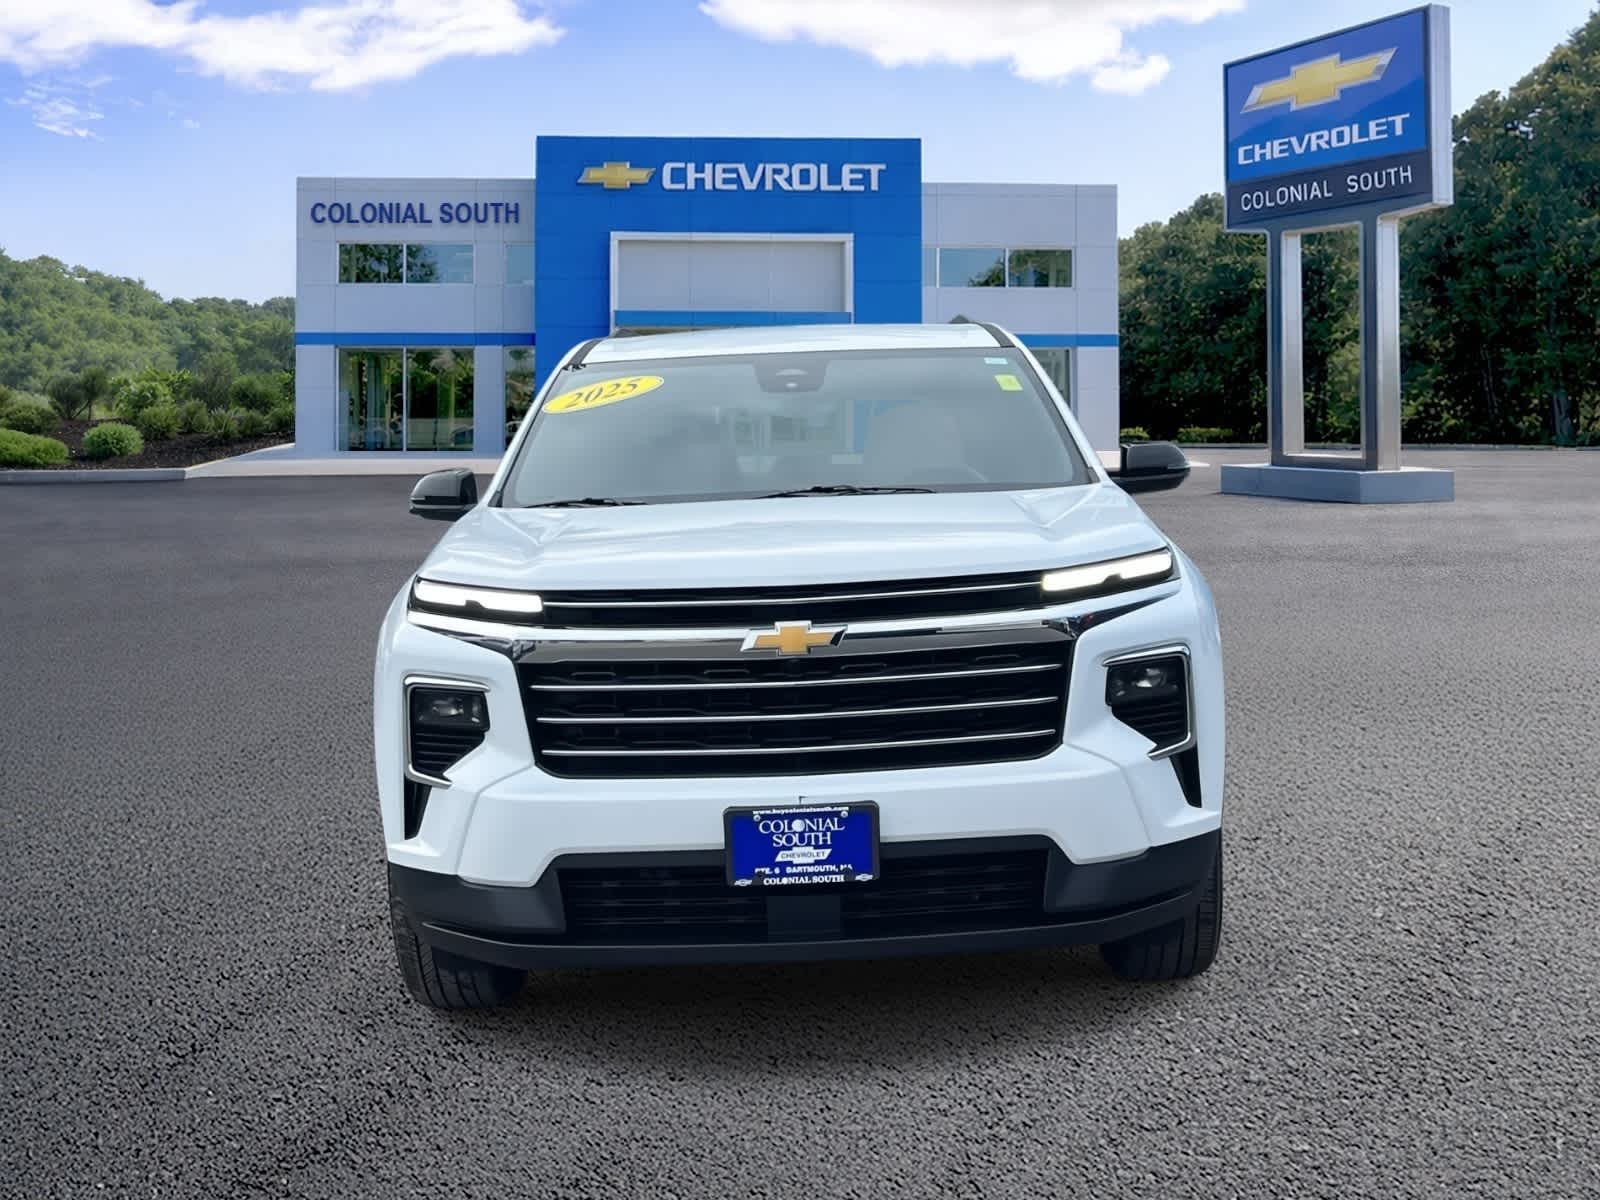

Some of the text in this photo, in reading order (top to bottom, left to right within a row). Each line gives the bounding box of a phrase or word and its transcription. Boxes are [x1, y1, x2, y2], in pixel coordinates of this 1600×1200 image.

[1238, 113, 1410, 165] CHEVROLET
[662, 162, 887, 191] CHEVROLET
[1240, 165, 1413, 211] COLONIAL SOUTH
[310, 202, 520, 224] COLONIAL SOUTH
[565, 378, 643, 408] 2025
[759, 817, 846, 834] COLONIAL
[772, 832, 832, 848] SOUTH
[780, 851, 826, 859] CHEVROLET
[763, 875, 845, 885] COLONIAL SOUTH
